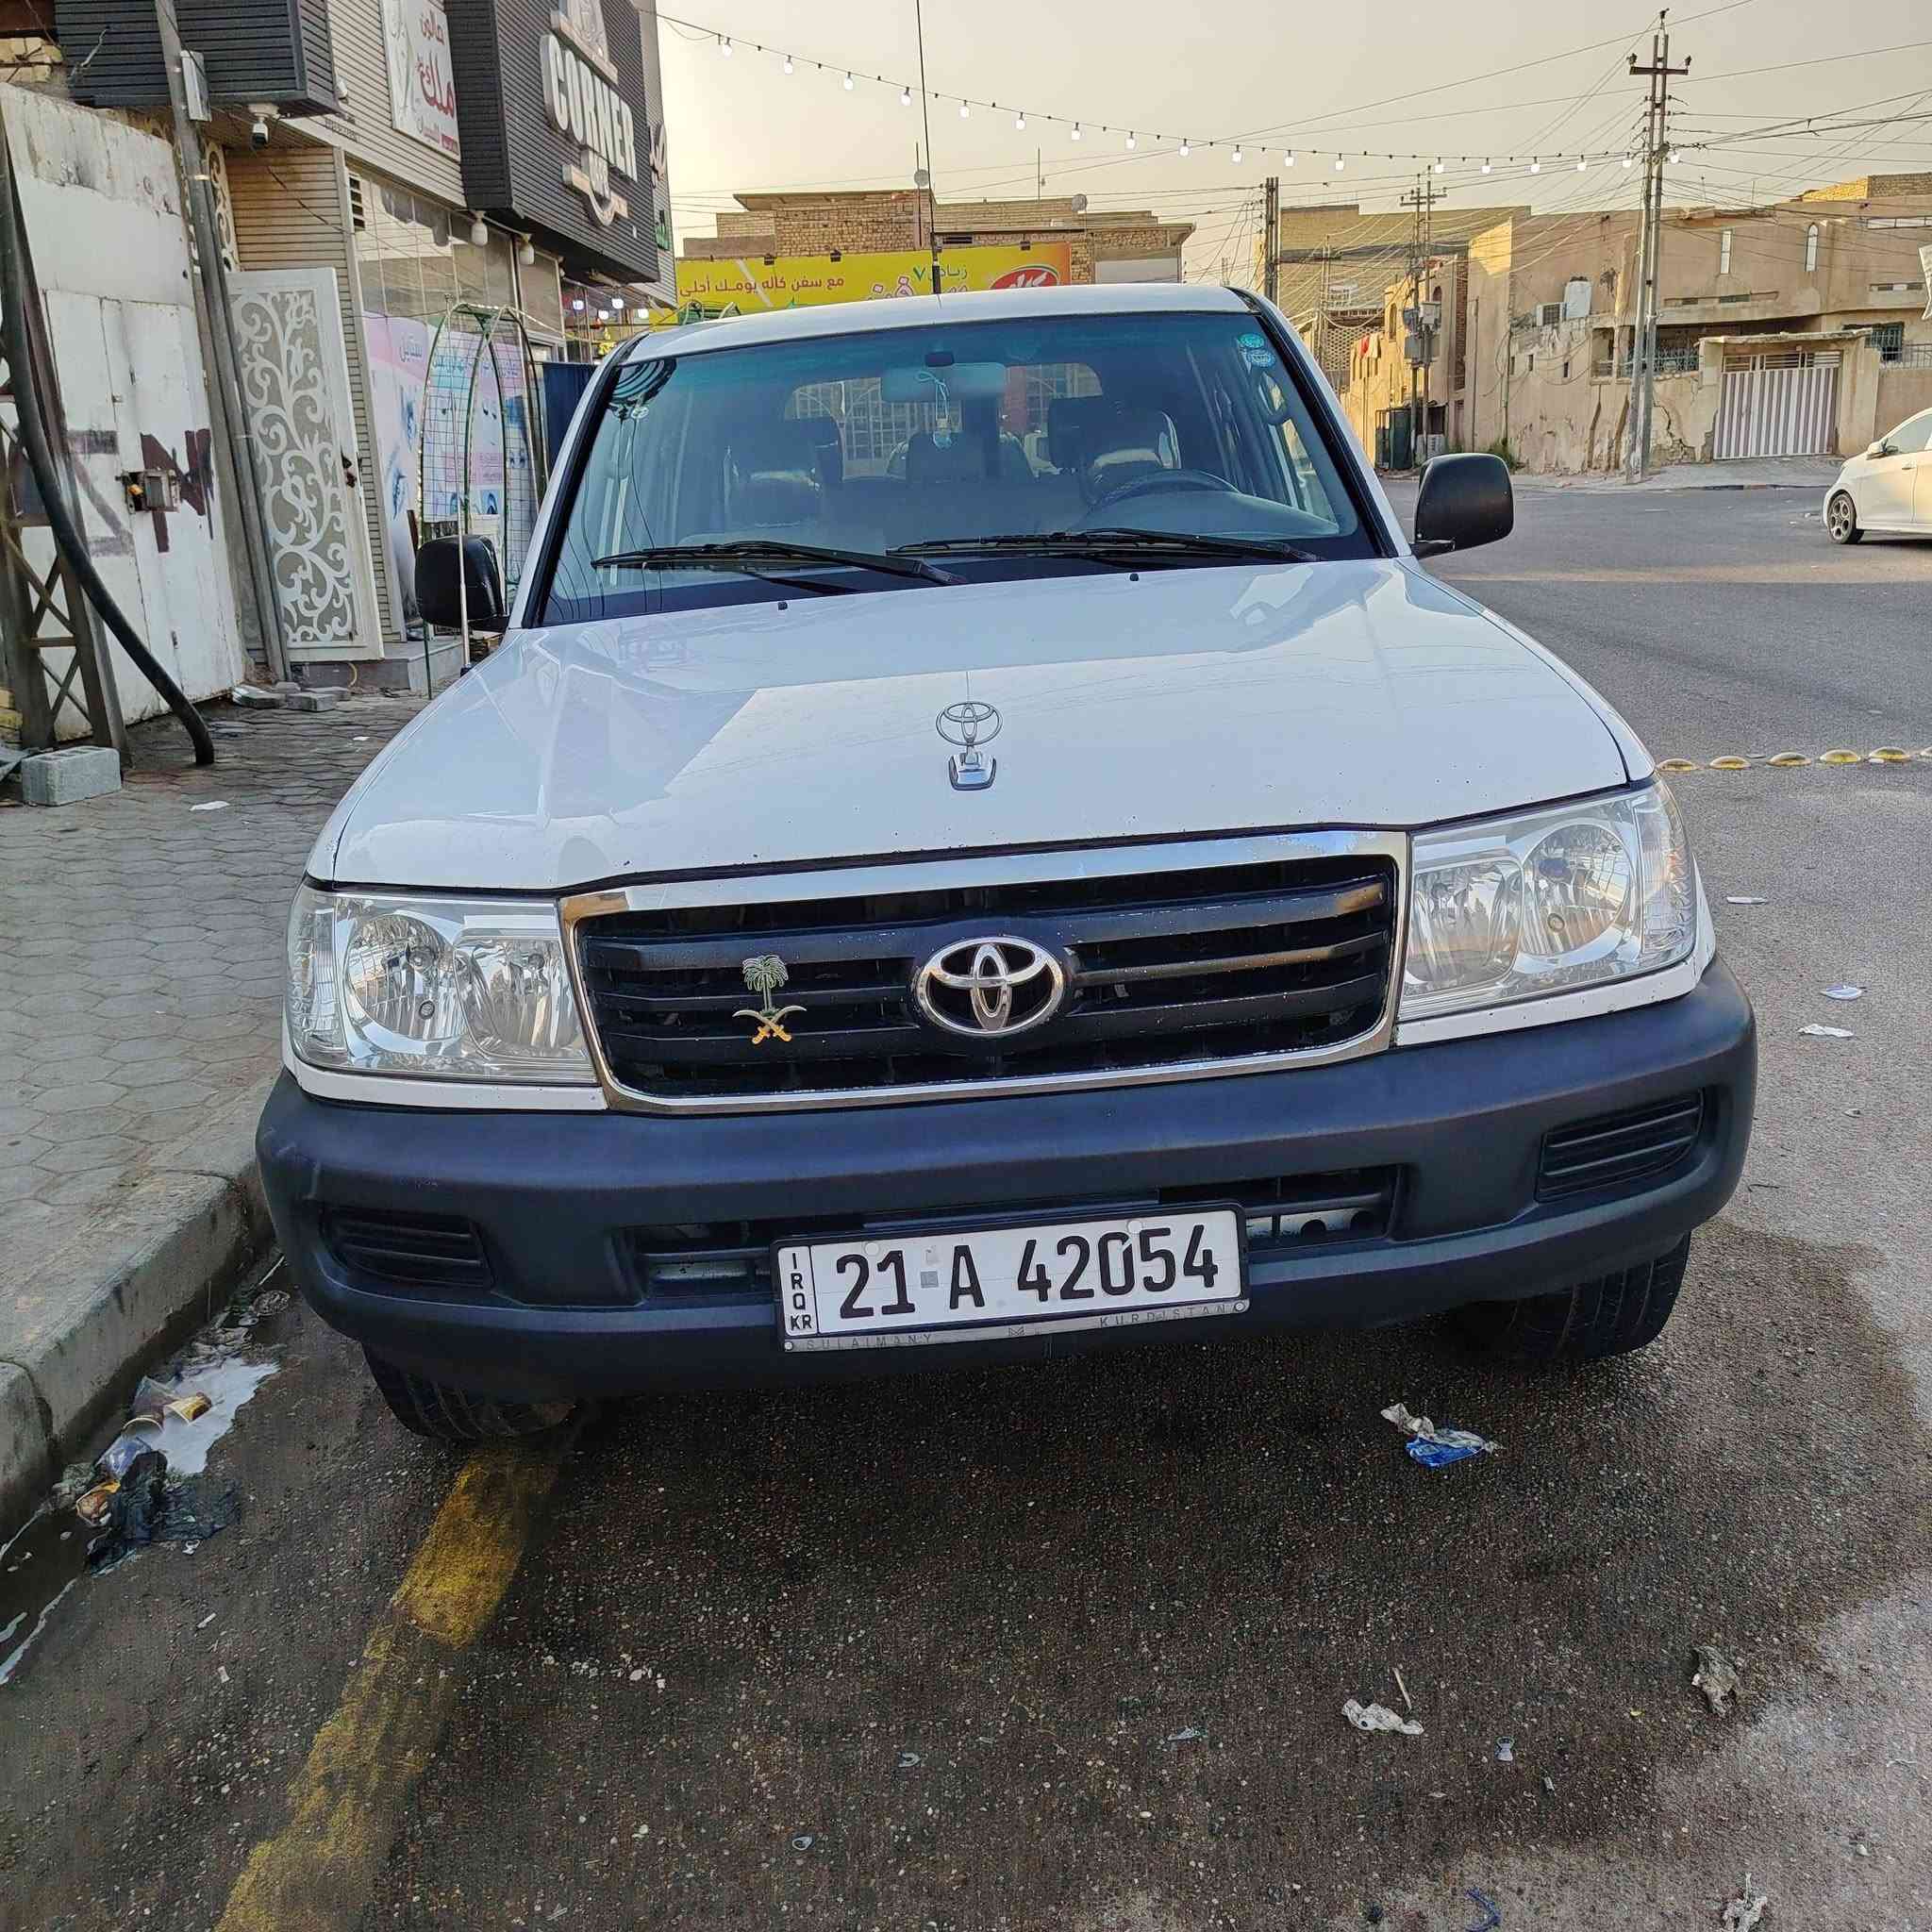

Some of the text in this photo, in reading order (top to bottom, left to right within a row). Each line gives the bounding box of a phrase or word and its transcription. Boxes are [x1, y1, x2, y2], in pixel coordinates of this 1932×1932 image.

[541, 34, 638, 183] CORNER
[791, 274, 822, 291] سفن
[826, 277, 845, 291] مع
[836, 1224, 1219, 1319] 21 A 42054
[791, 1314, 812, 1330] KR
[1100, 1304, 1225, 1327] KURDISTAN
